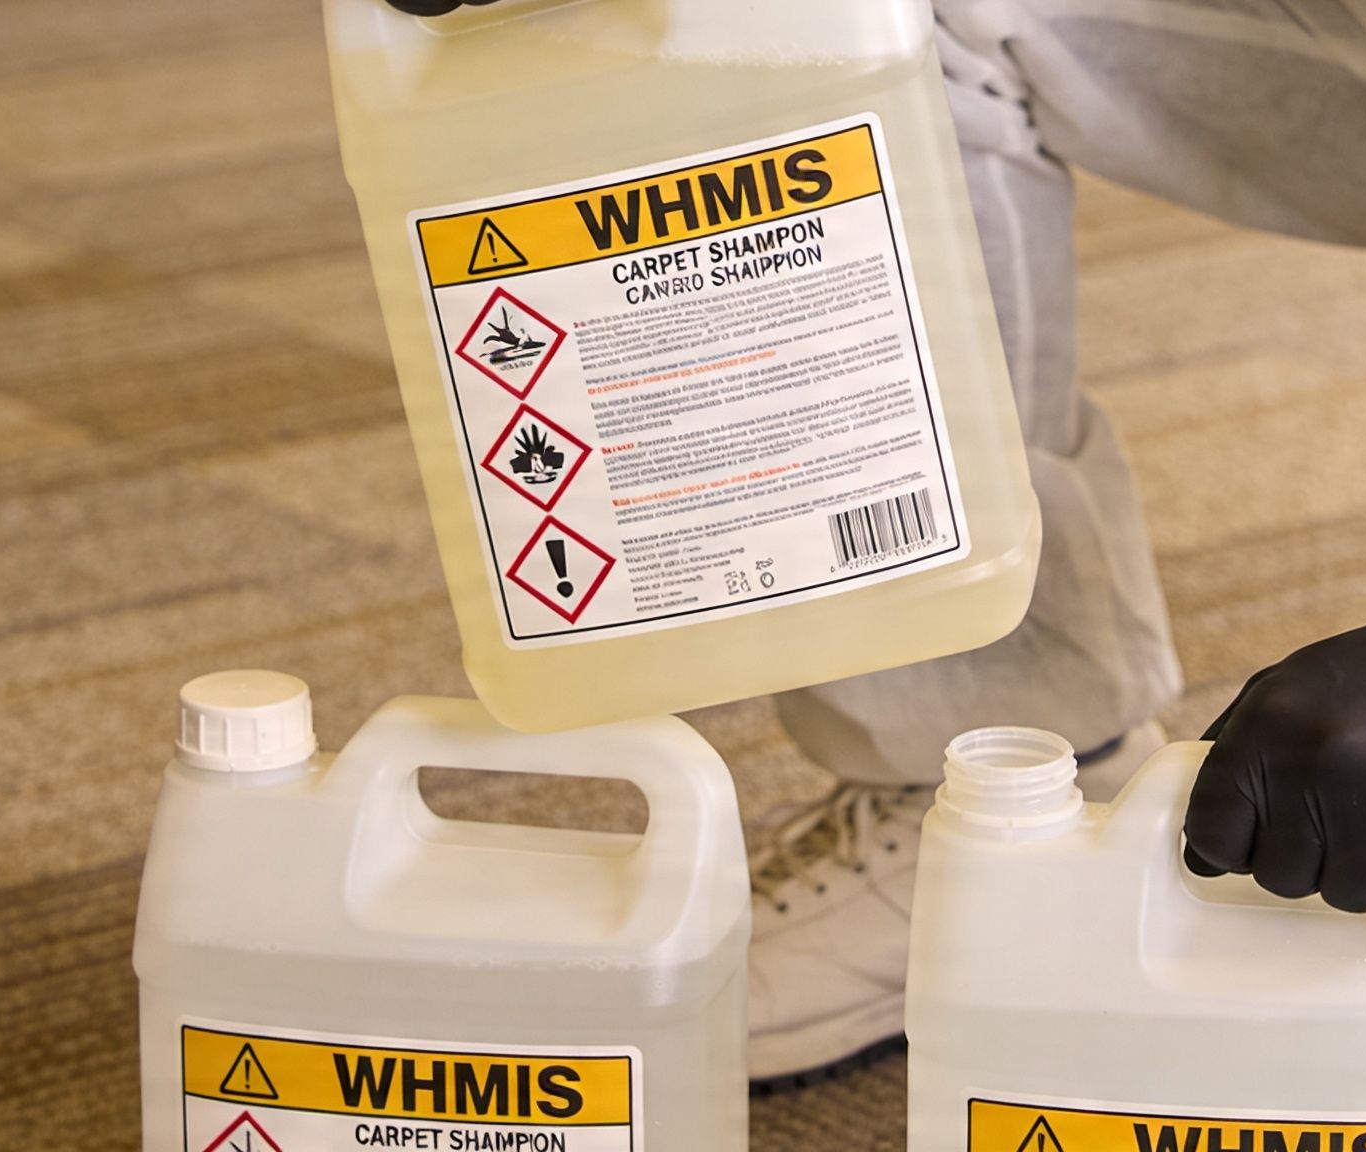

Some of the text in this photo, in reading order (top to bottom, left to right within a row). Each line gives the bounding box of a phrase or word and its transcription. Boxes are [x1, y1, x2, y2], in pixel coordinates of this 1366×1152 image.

[575, 149, 833, 251] WHMIS
[612, 247, 701, 284] CARPET
[332, 1052, 584, 1119] WHMIS
[354, 1123, 444, 1149] CARPET
